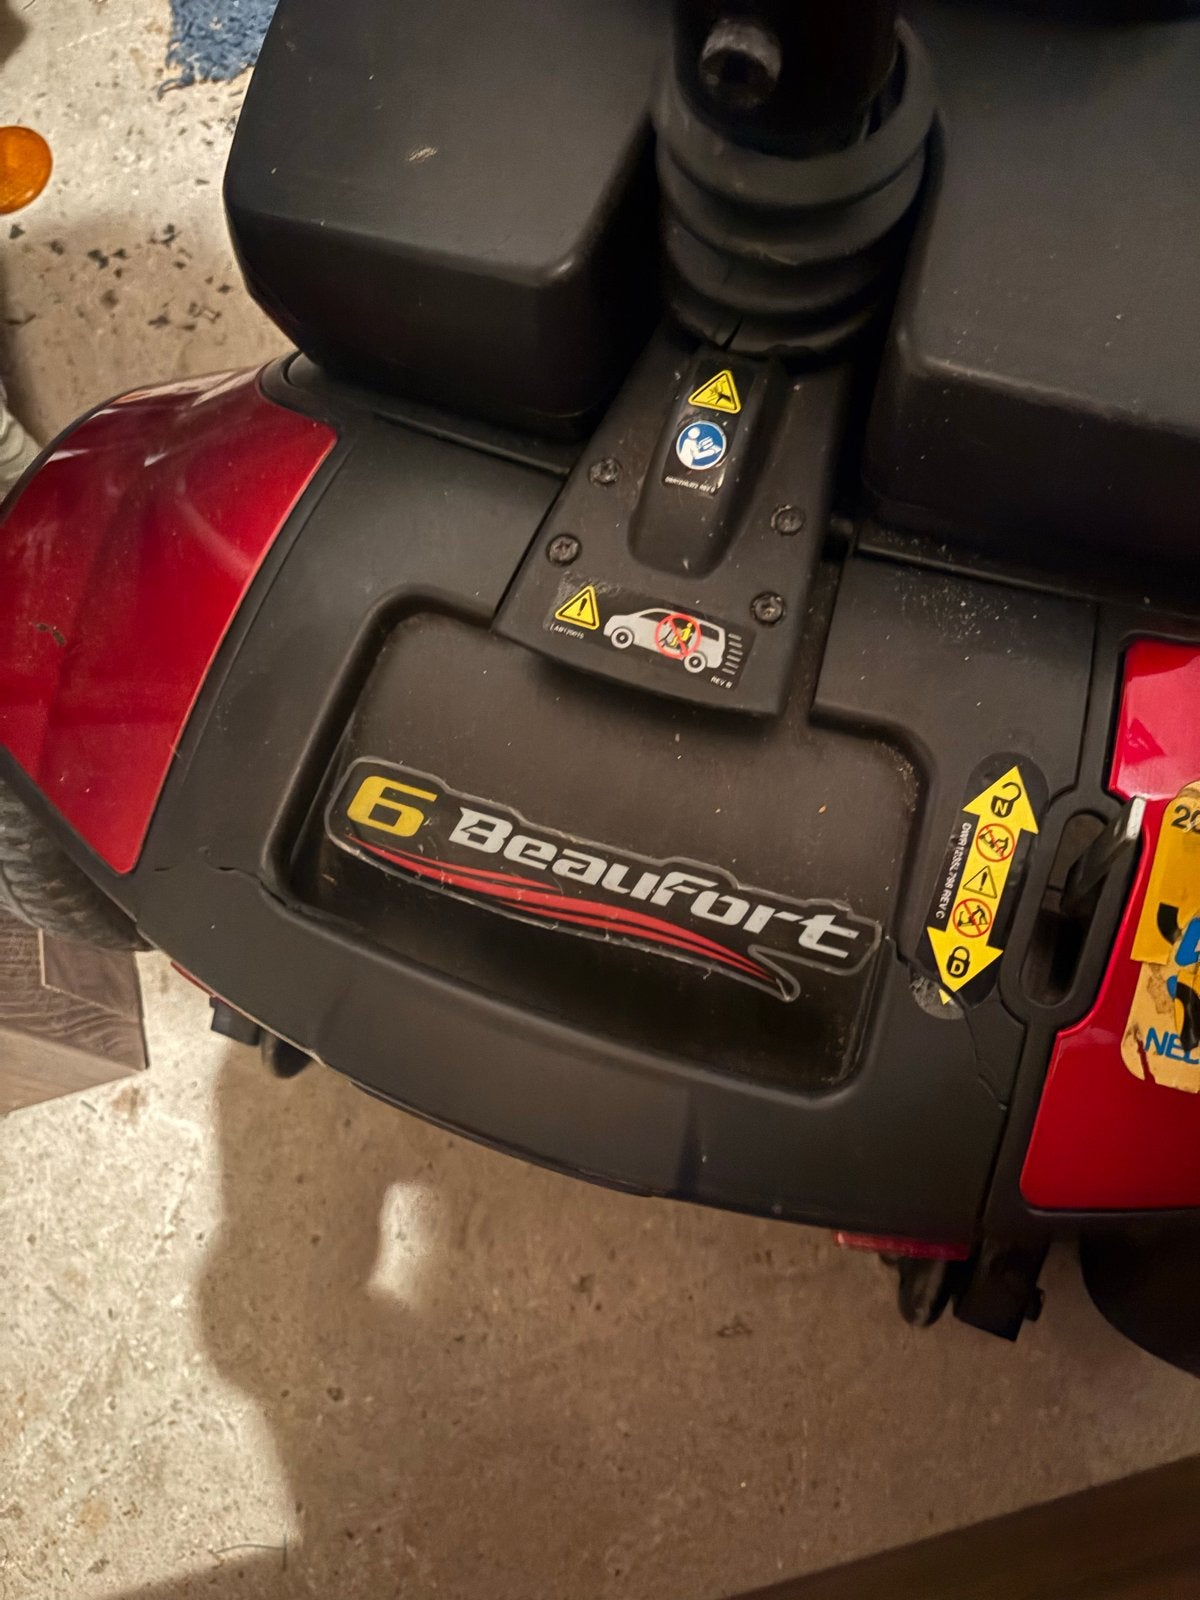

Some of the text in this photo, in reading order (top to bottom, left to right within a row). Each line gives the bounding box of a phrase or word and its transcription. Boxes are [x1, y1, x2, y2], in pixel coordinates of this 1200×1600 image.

[346, 775, 861, 959] 6 Beaufort
[938, 888, 952, 911] REV
[935, 910, 946, 920] C
